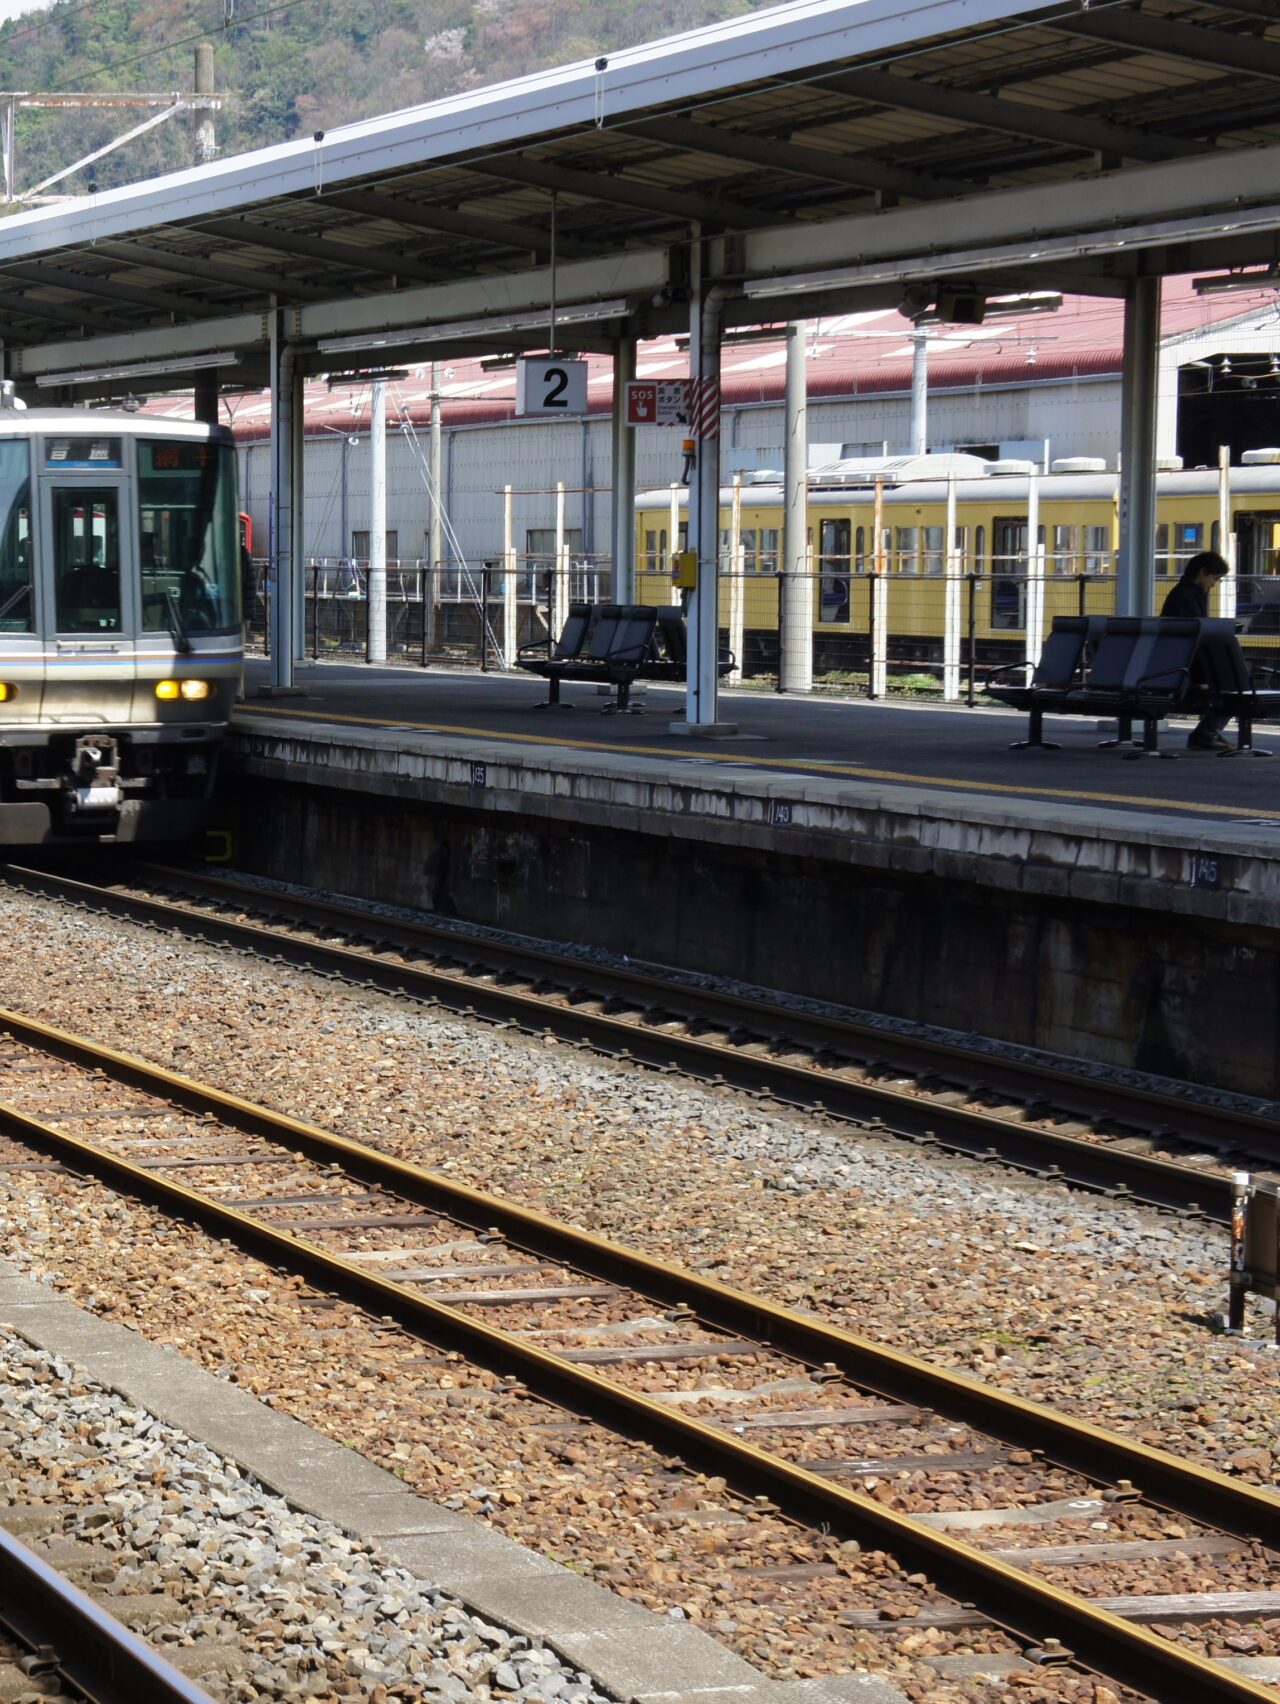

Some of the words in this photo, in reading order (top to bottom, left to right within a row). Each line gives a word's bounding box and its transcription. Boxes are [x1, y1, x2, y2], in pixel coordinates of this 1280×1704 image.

[543, 368, 568, 408] 2
[631, 391, 654, 400] SOS
[658, 395, 681, 403] ボタン
[1198, 858, 1219, 882] 145
